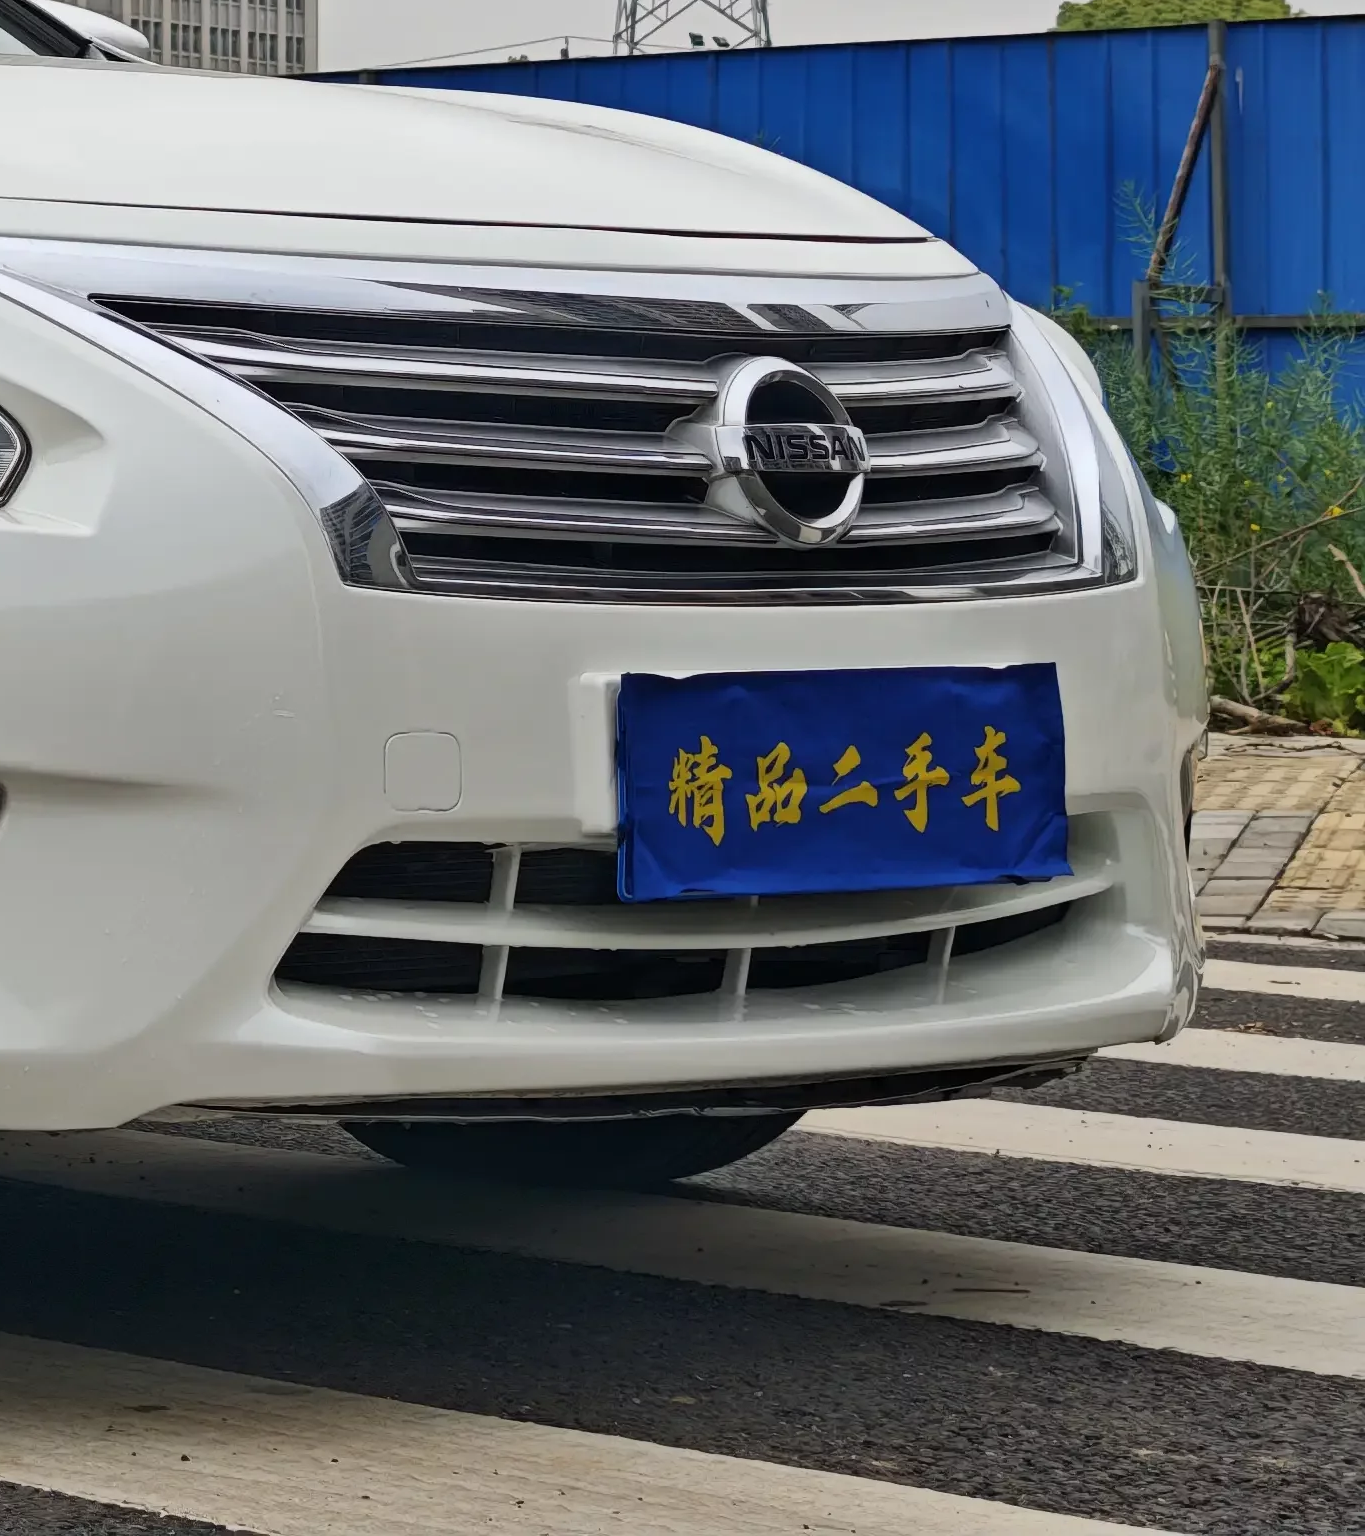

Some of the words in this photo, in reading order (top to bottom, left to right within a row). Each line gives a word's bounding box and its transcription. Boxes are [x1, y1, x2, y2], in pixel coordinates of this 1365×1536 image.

[743, 434, 866, 462] NISSAN
[669, 726, 1022, 846] 精品二手车
